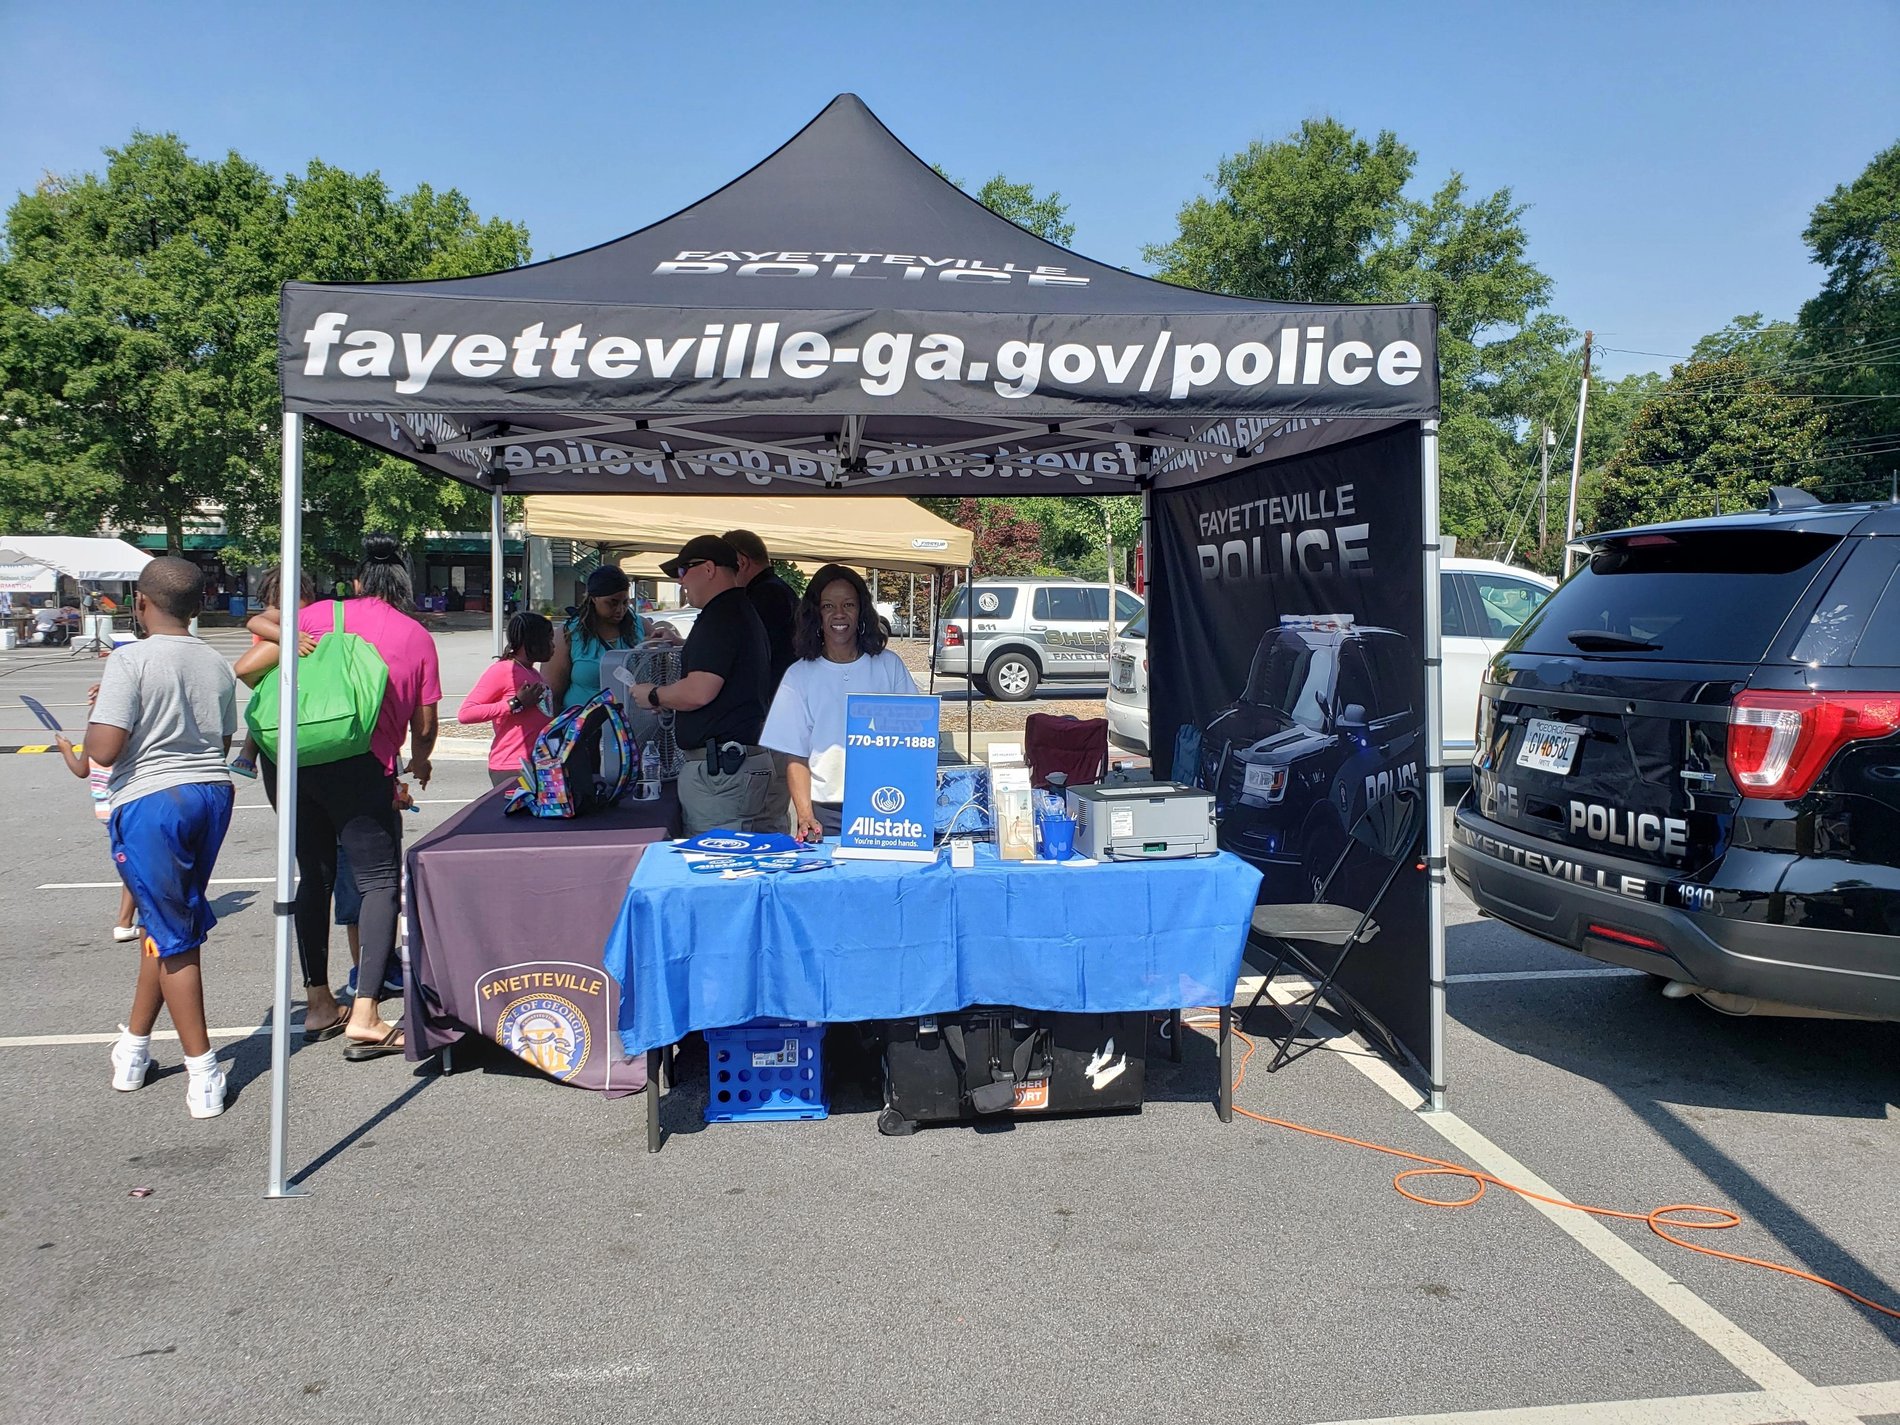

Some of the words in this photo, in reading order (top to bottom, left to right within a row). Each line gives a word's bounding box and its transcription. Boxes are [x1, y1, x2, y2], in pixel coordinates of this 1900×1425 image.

[651, 261, 1091, 288] POLICE
[674, 250, 1068, 276] FAYETTEVILLE
[302, 311, 1423, 399] fayetteville-ga.gov/police
[1199, 483, 1357, 537] FAYETTEVILLE
[1197, 523, 1375, 584] POLICE
[1044, 630, 1113, 646] SHER
[847, 734, 937, 749] 770-817-1888
[1538, 723, 1567, 735] GEORGI
[1569, 799, 1688, 857] POLICE
[874, 838, 881, 846] in
[881, 839, 898, 848] good
[898, 839, 919, 848] hands.
[1677, 884, 1715, 909] 1810
[481, 972, 603, 1001] FAYETTEVILLE
[520, 1000, 539, 1013] OF
[541, 1000, 585, 1043] GEORGIA
